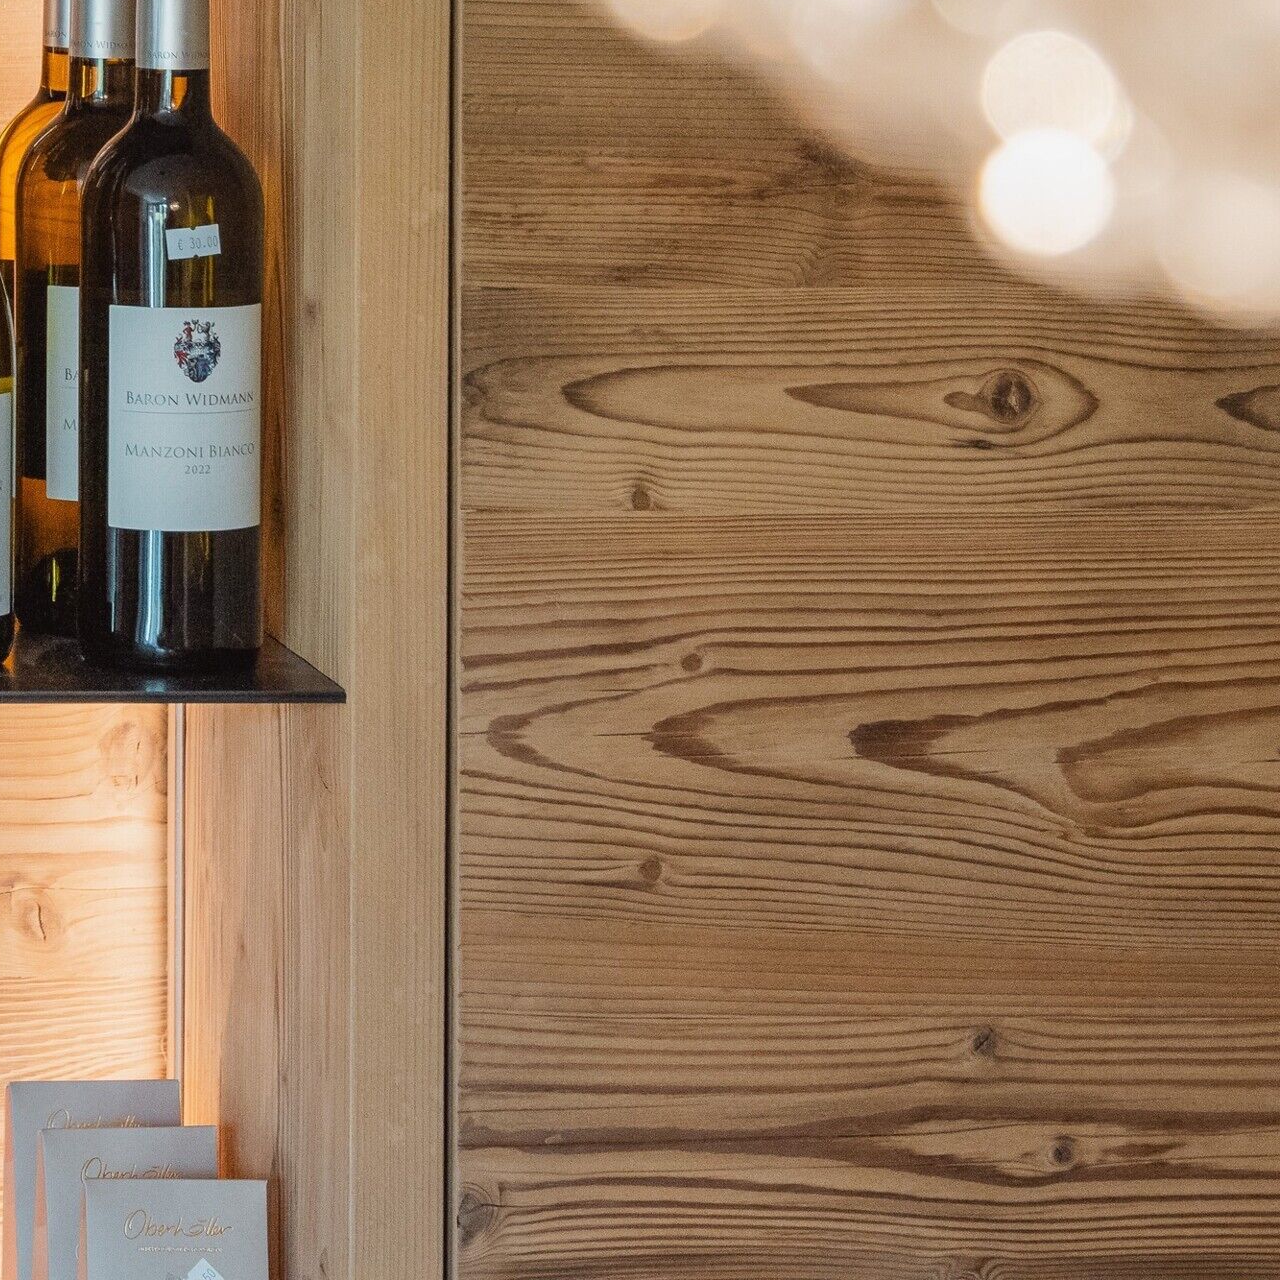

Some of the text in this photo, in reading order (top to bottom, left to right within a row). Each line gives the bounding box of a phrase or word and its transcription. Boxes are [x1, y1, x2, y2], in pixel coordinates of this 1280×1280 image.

[190, 236, 217, 249] 30.00
[127, 390, 254, 406] BARON WIDMANN
[125, 443, 255, 458] MANZONI BIANCO
[185, 465, 211, 474] 2022
